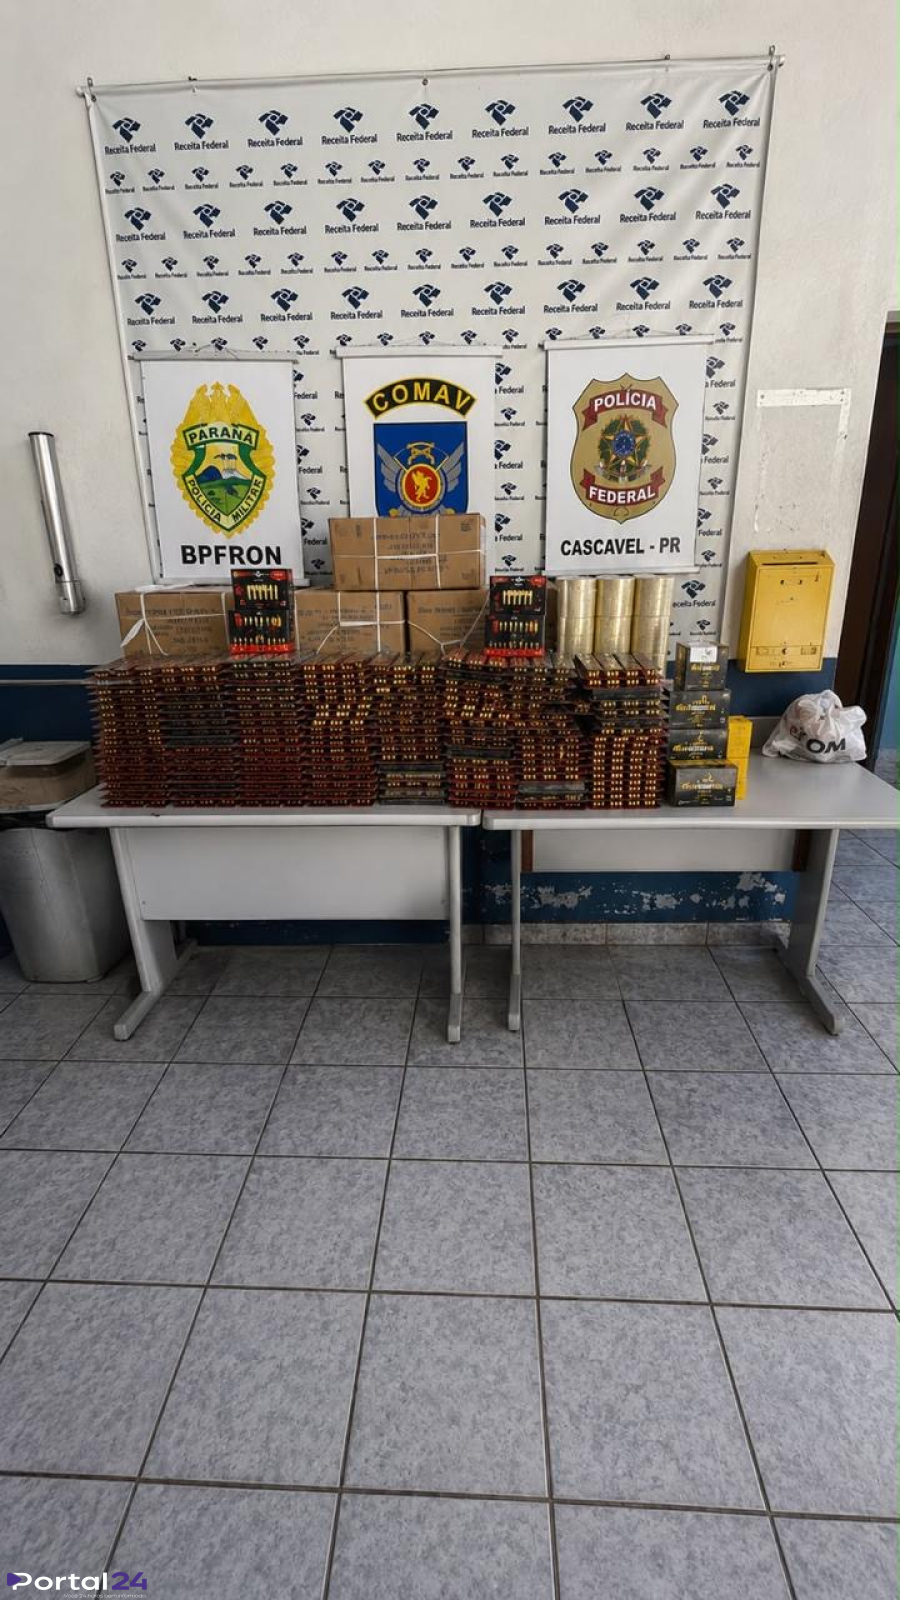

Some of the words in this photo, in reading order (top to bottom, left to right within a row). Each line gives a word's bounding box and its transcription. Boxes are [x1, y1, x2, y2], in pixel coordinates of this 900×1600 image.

[626, 121, 654, 130] Receita
[655, 120, 684, 129] Federal
[703, 119, 731, 128] Receita
[733, 117, 760, 126] Federal
[472, 129, 500, 138] Receita
[501, 127, 529, 136] Federal
[549, 125, 576, 134] Receita
[578, 123, 606, 133] Federal
[321, 135, 349, 145] Receita
[350, 134, 377, 144] Federal
[396, 132, 424, 141] Receita
[425, 130, 453, 140] Federal
[174, 142, 200, 150] Receita
[202, 140, 229, 149] Federal
[247, 138, 275, 147] Receita
[276, 137, 303, 146] Federal
[105, 145, 129, 155] Receita
[130, 144, 156, 153] Federal
[620, 214, 647, 223] Receita
[649, 212, 676, 221] Federal
[695, 210, 723, 219] Receita
[725, 210, 751, 219] Federal
[470, 219, 497, 228] Receita
[498, 217, 525, 226] Federal
[545, 216, 572, 225] Receita
[574, 215, 600, 224] Federal
[325, 225, 351, 234] Receita
[352, 224, 379, 232] Federal
[397, 222, 423, 230] Receita
[425, 221, 451, 230] Federal
[183, 230, 209, 239] Receita
[210, 229, 235, 238] Federal
[253, 227, 279, 236] Receita
[280, 226, 307, 235] Federal
[116, 234, 140, 242] Receita
[141, 232, 165, 240] Federal
[544, 305, 570, 313] Receita
[571, 303, 598, 312] Federal
[616, 302, 643, 310] Receita
[645, 301, 670, 310] Federal
[689, 300, 715, 309] Receita
[716, 300, 743, 308] Federal
[331, 312, 356, 320] Receita
[357, 310, 383, 319] Federal
[428, 309, 454, 317] Federal
[472, 307, 497, 315] Receita
[499, 306, 525, 315] Federal
[192, 315, 217, 324] Receita
[218, 315, 243, 323] Federal
[287, 312, 313, 321] Federal
[127, 318, 150, 326] Receita
[710, 379, 736, 388] Federal
[498, 385, 524, 394] Federal
[373, 381, 471, 411] COMAV
[594, 389, 656, 412] POLÍCIA
[498, 460, 524, 469] Federal
[704, 456, 730, 464] Federal
[299, 466, 323, 474] Federal
[589, 485, 656, 504] FEDERAL
[232, 479, 262, 522] MILITAR
[498, 533, 523, 541] Federal
[698, 529, 723, 537] Federal
[561, 538, 645, 556] CASCAVEL
[659, 537, 681, 553] PR
[181, 545, 281, 565] BPFRON
[693, 599, 717, 607] Federal
